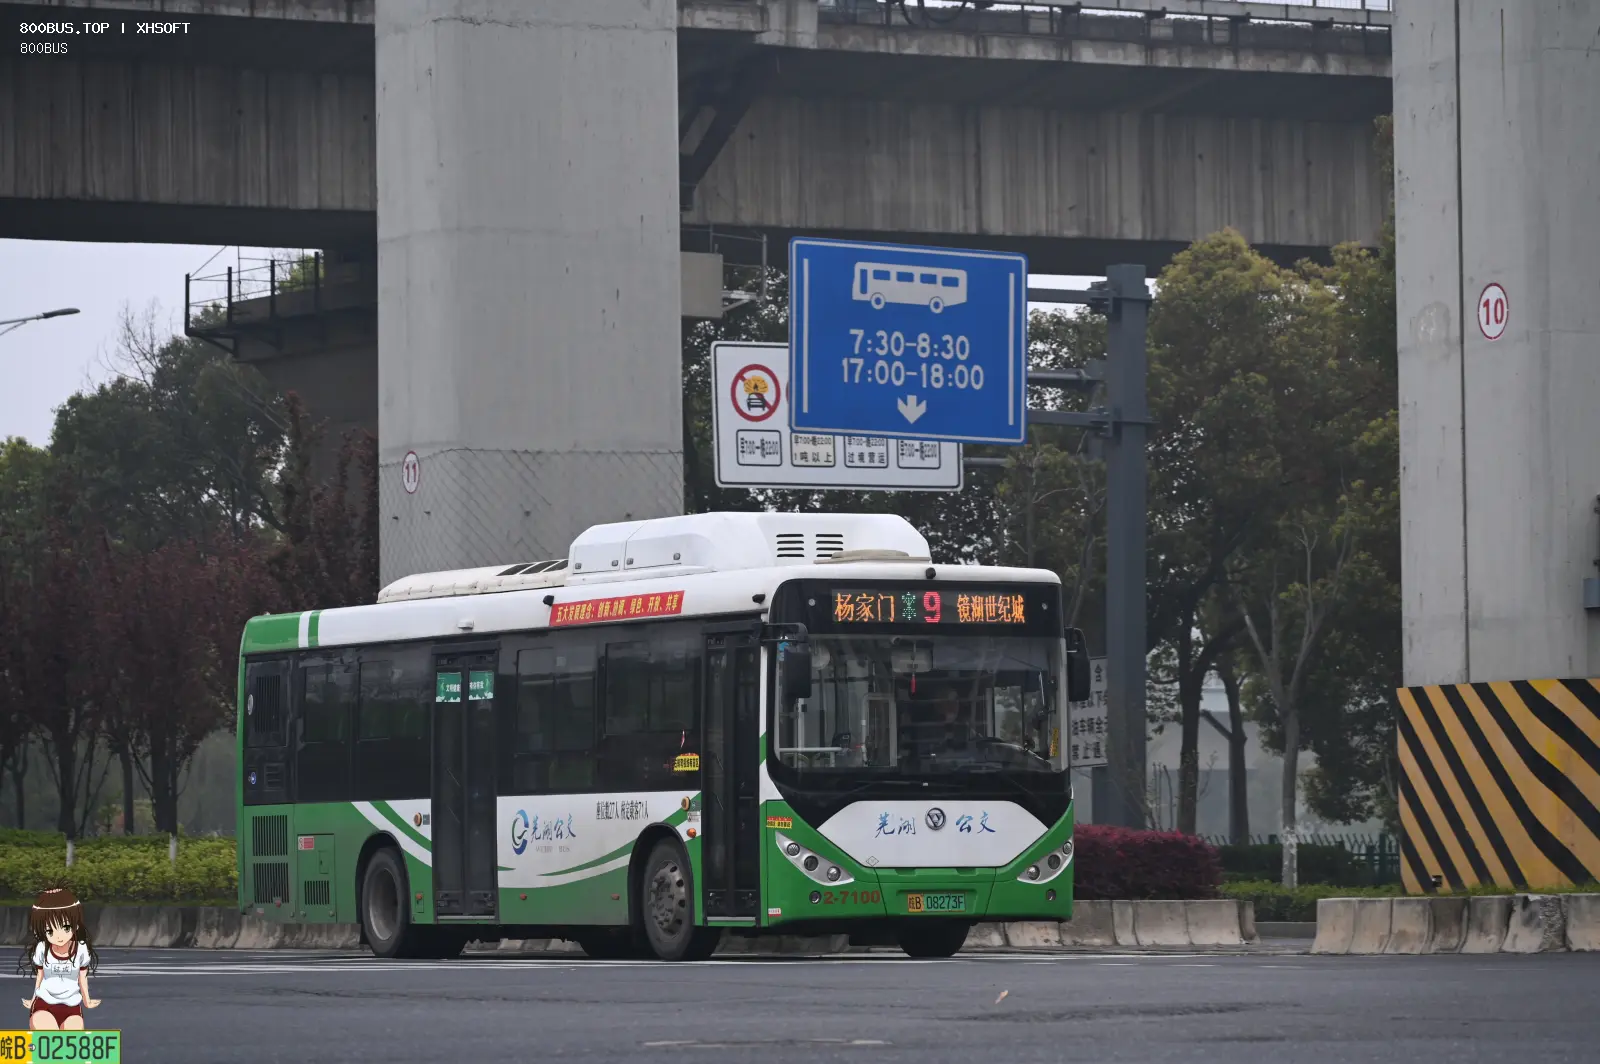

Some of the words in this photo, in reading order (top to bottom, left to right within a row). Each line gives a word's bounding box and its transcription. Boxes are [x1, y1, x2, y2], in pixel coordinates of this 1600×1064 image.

[1483, 298, 1504, 325] 10
[849, 329, 970, 361] 7:30-8:30
[842, 357, 984, 390] 17:00-18:00
[405, 463, 416, 483] 11
[834, 592, 895, 623] 杨家门
[923, 591, 941, 623] 9
[957, 593, 1025, 623] 镜湖世纪城
[955, 810, 996, 834] 公交
[823, 891, 881, 905] 2-7100
